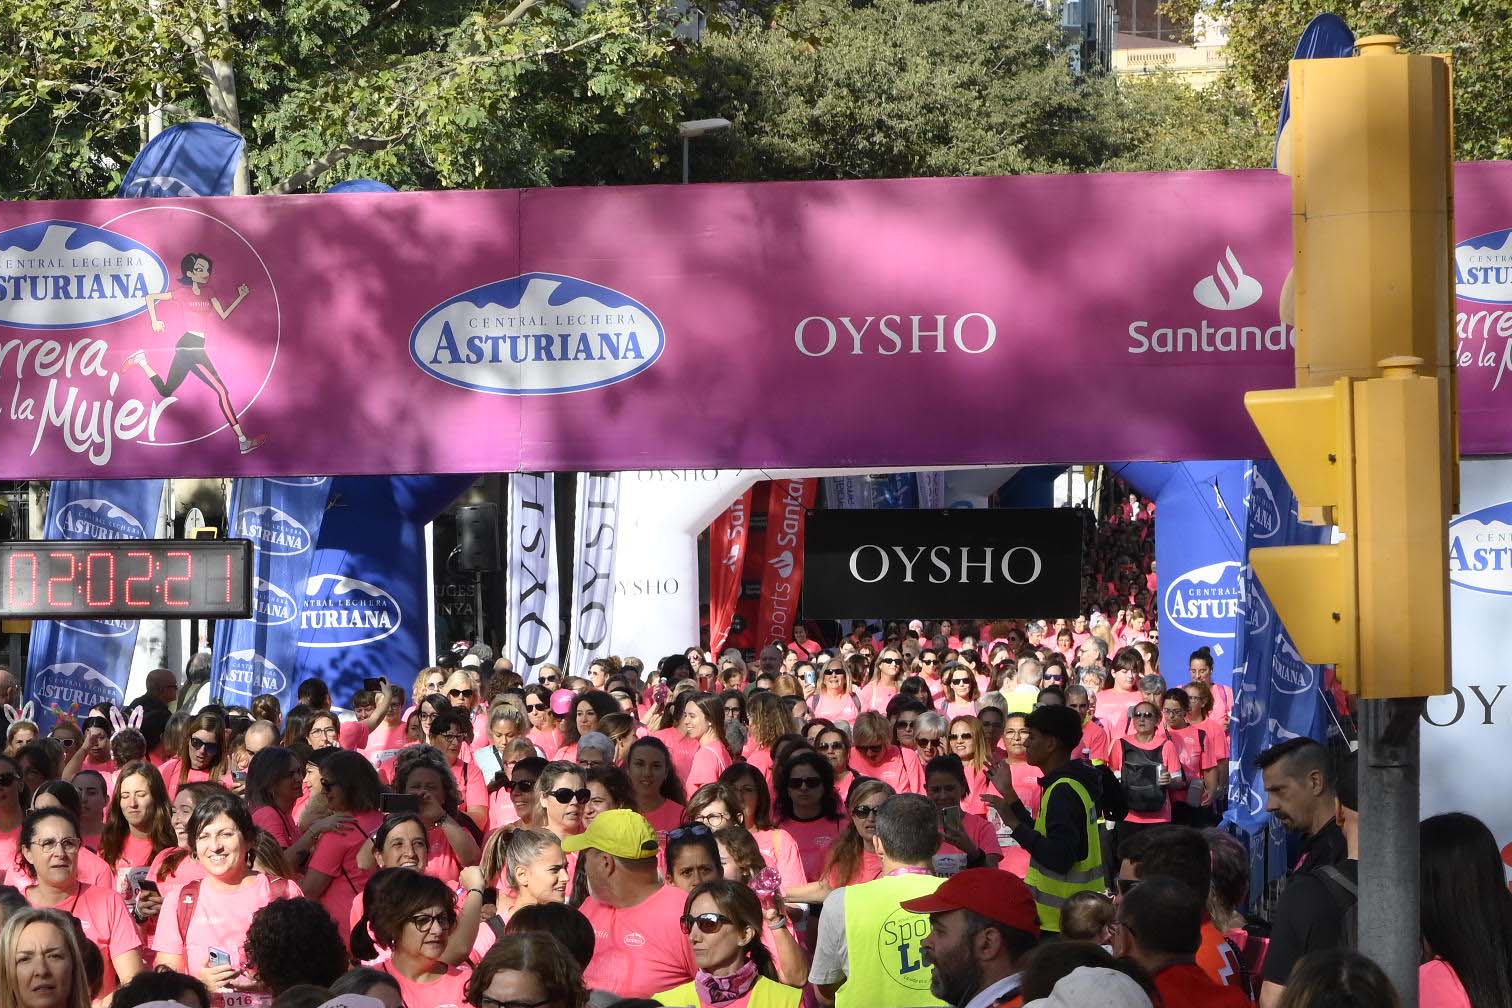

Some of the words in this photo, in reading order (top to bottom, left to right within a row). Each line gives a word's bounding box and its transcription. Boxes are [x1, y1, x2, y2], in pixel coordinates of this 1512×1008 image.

[71, 256, 144, 270] LECHERA
[469, 313, 548, 330] CENTRAL
[555, 312, 637, 328] LECHERA
[794, 311, 998, 358] OYSHO
[1128, 318, 1296, 354] Santand
[429, 319, 645, 365] ASTURIANA
[10, 381, 36, 421] la
[30, 373, 179, 466] Mujer
[517, 472, 555, 666] OYSH
[578, 472, 616, 651] OYSH
[848, 543, 1044, 585] OYSHO
[300, 609, 393, 630] TURIANA
[303, 600, 334, 608] NTRAL
[338, 599, 388, 608] LECHERA
[884, 920, 927, 946] Spo
[226, 996, 253, 1007] 016
